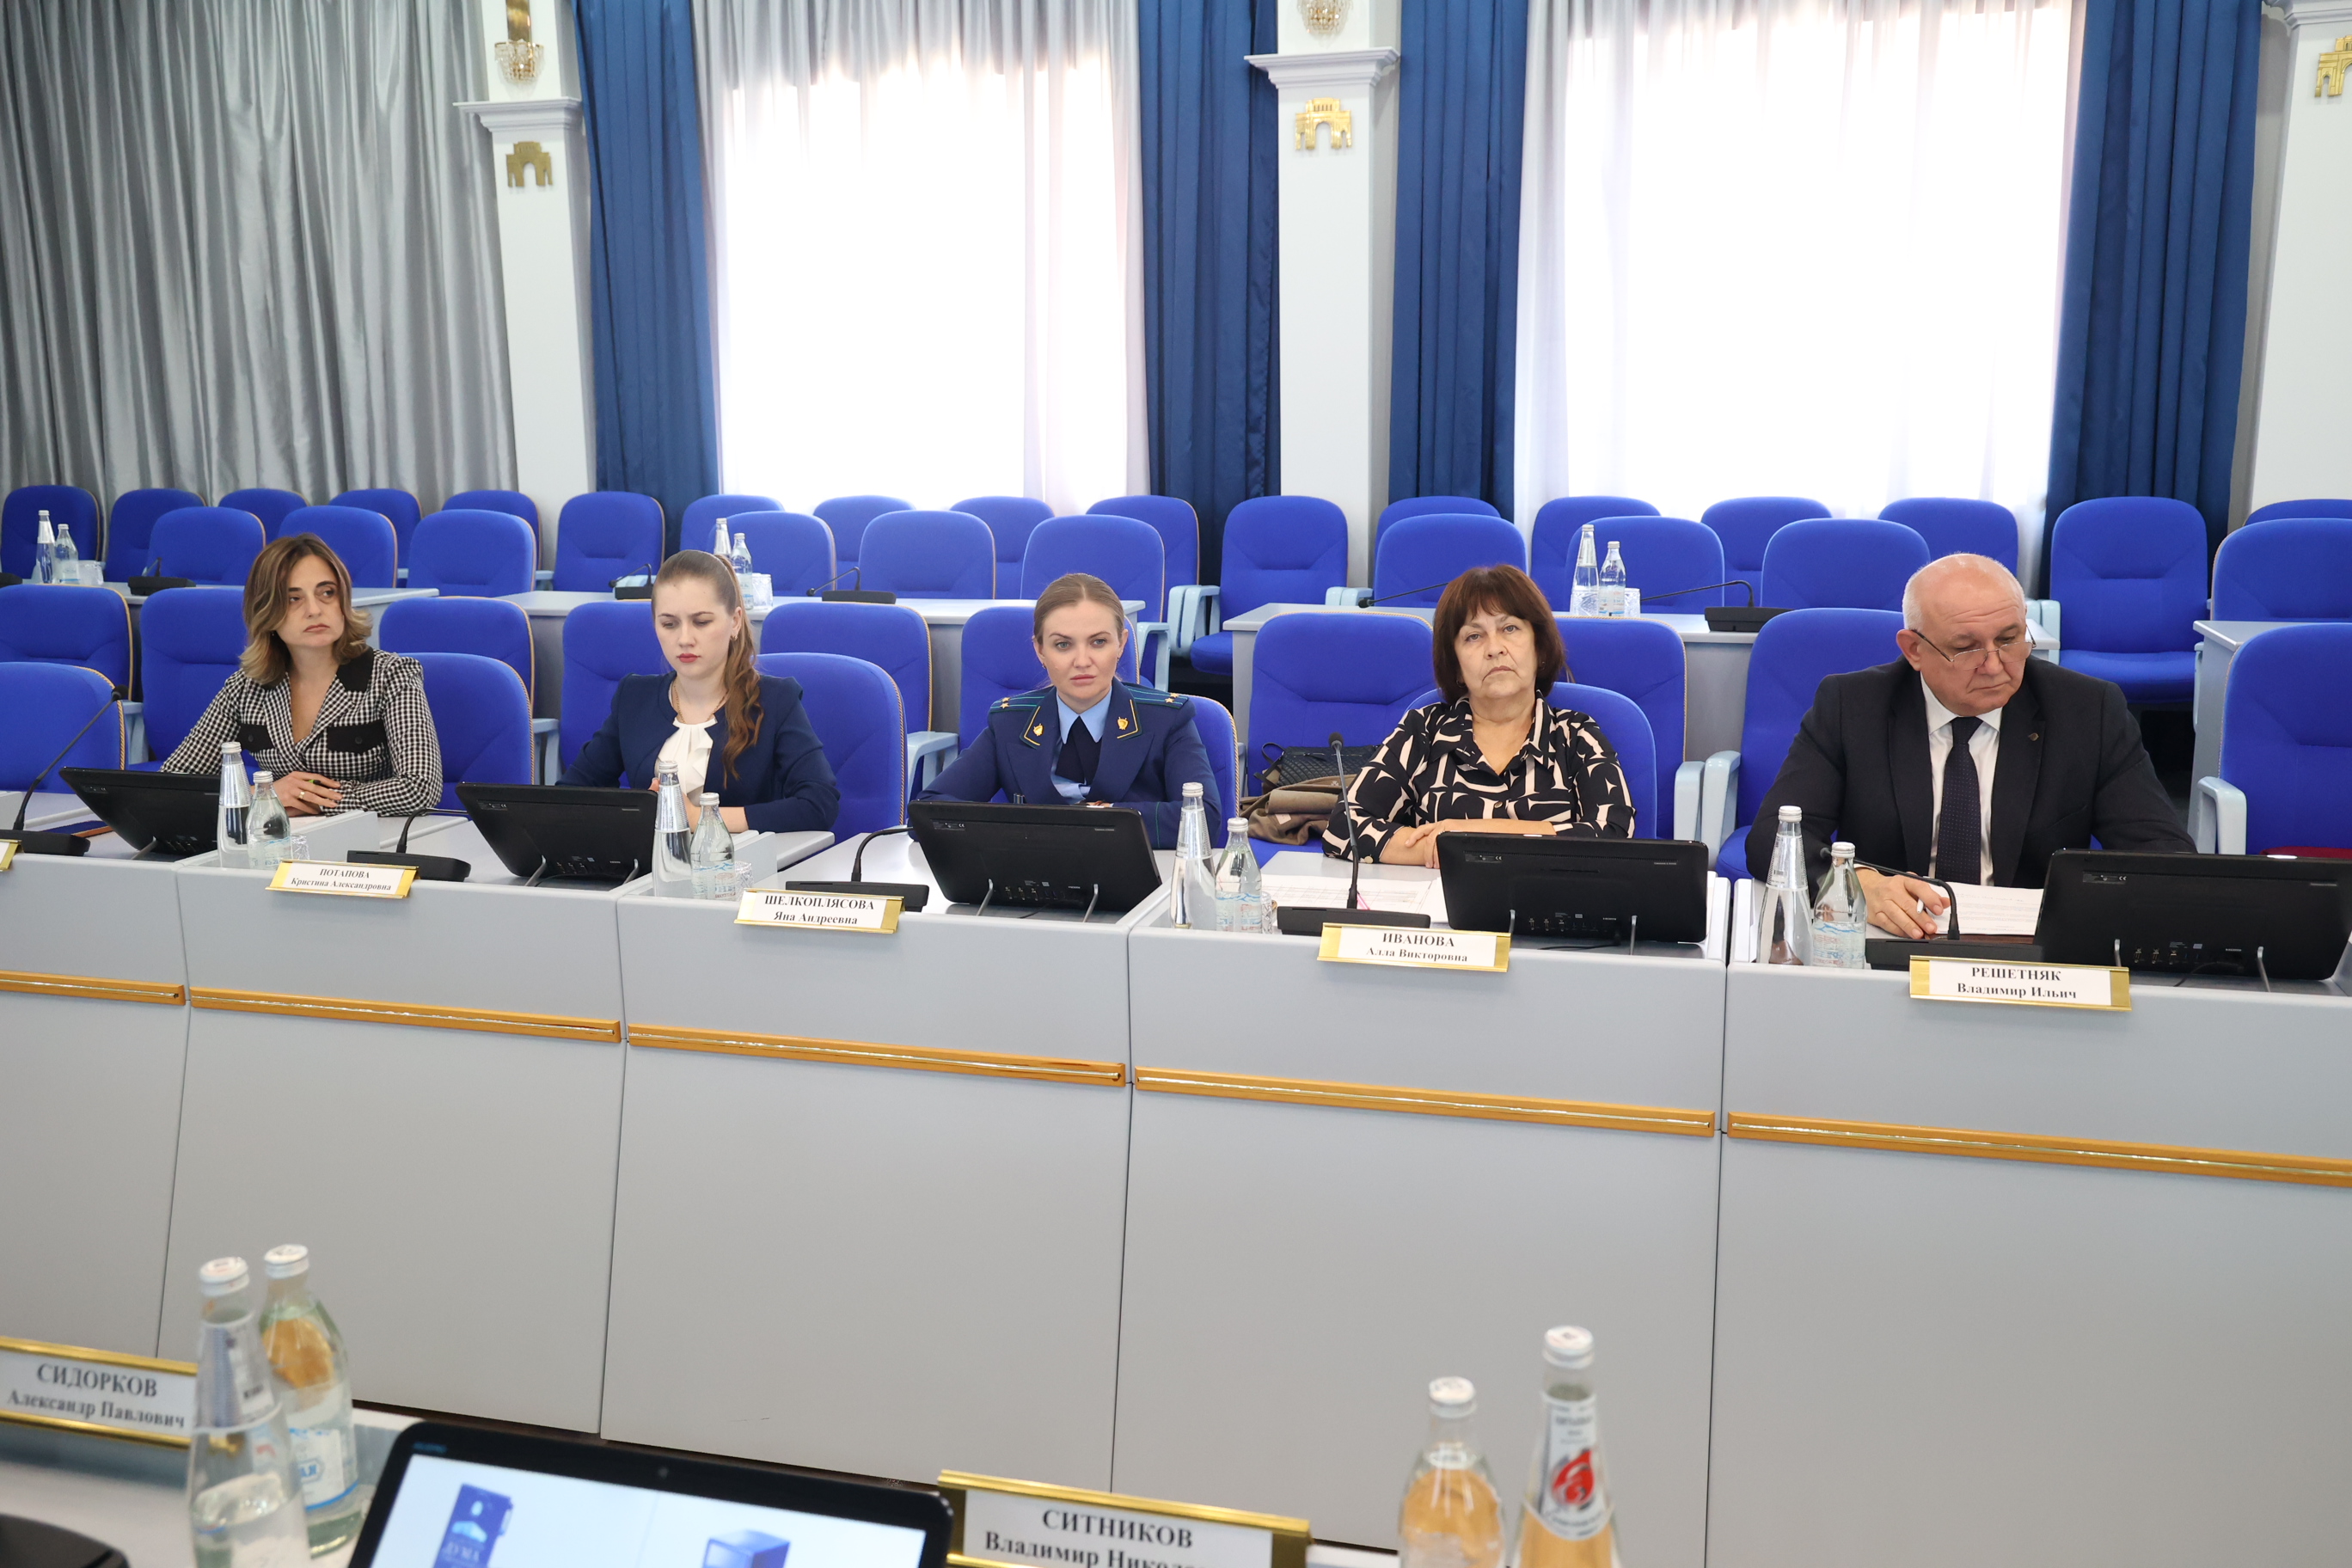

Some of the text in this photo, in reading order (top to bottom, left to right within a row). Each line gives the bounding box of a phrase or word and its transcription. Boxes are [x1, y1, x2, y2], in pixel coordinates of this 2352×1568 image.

[320, 868, 370, 879] ПОТАПОВА
[291, 878, 391, 891] Кристина Александровна
[765, 895, 874, 910] ШЕЛКОПЛЯСОВА
[773, 911, 857, 925] Яна Андреевна
[1382, 933, 1455, 947] ИВАНОВА
[1366, 947, 1467, 962] Алла Викторовна
[1971, 967, 2061, 981] РЕШЕТНЯК
[1957, 983, 2076, 999] Владимир Ильич
[37, 1363, 157, 1398] СИДОРКОВ
[8, 1389, 185, 1428] Александр Павлович
[1043, 1509, 1193, 1548] СИТНИКОВ
[985, 1531, 1099, 1568] Владимир
